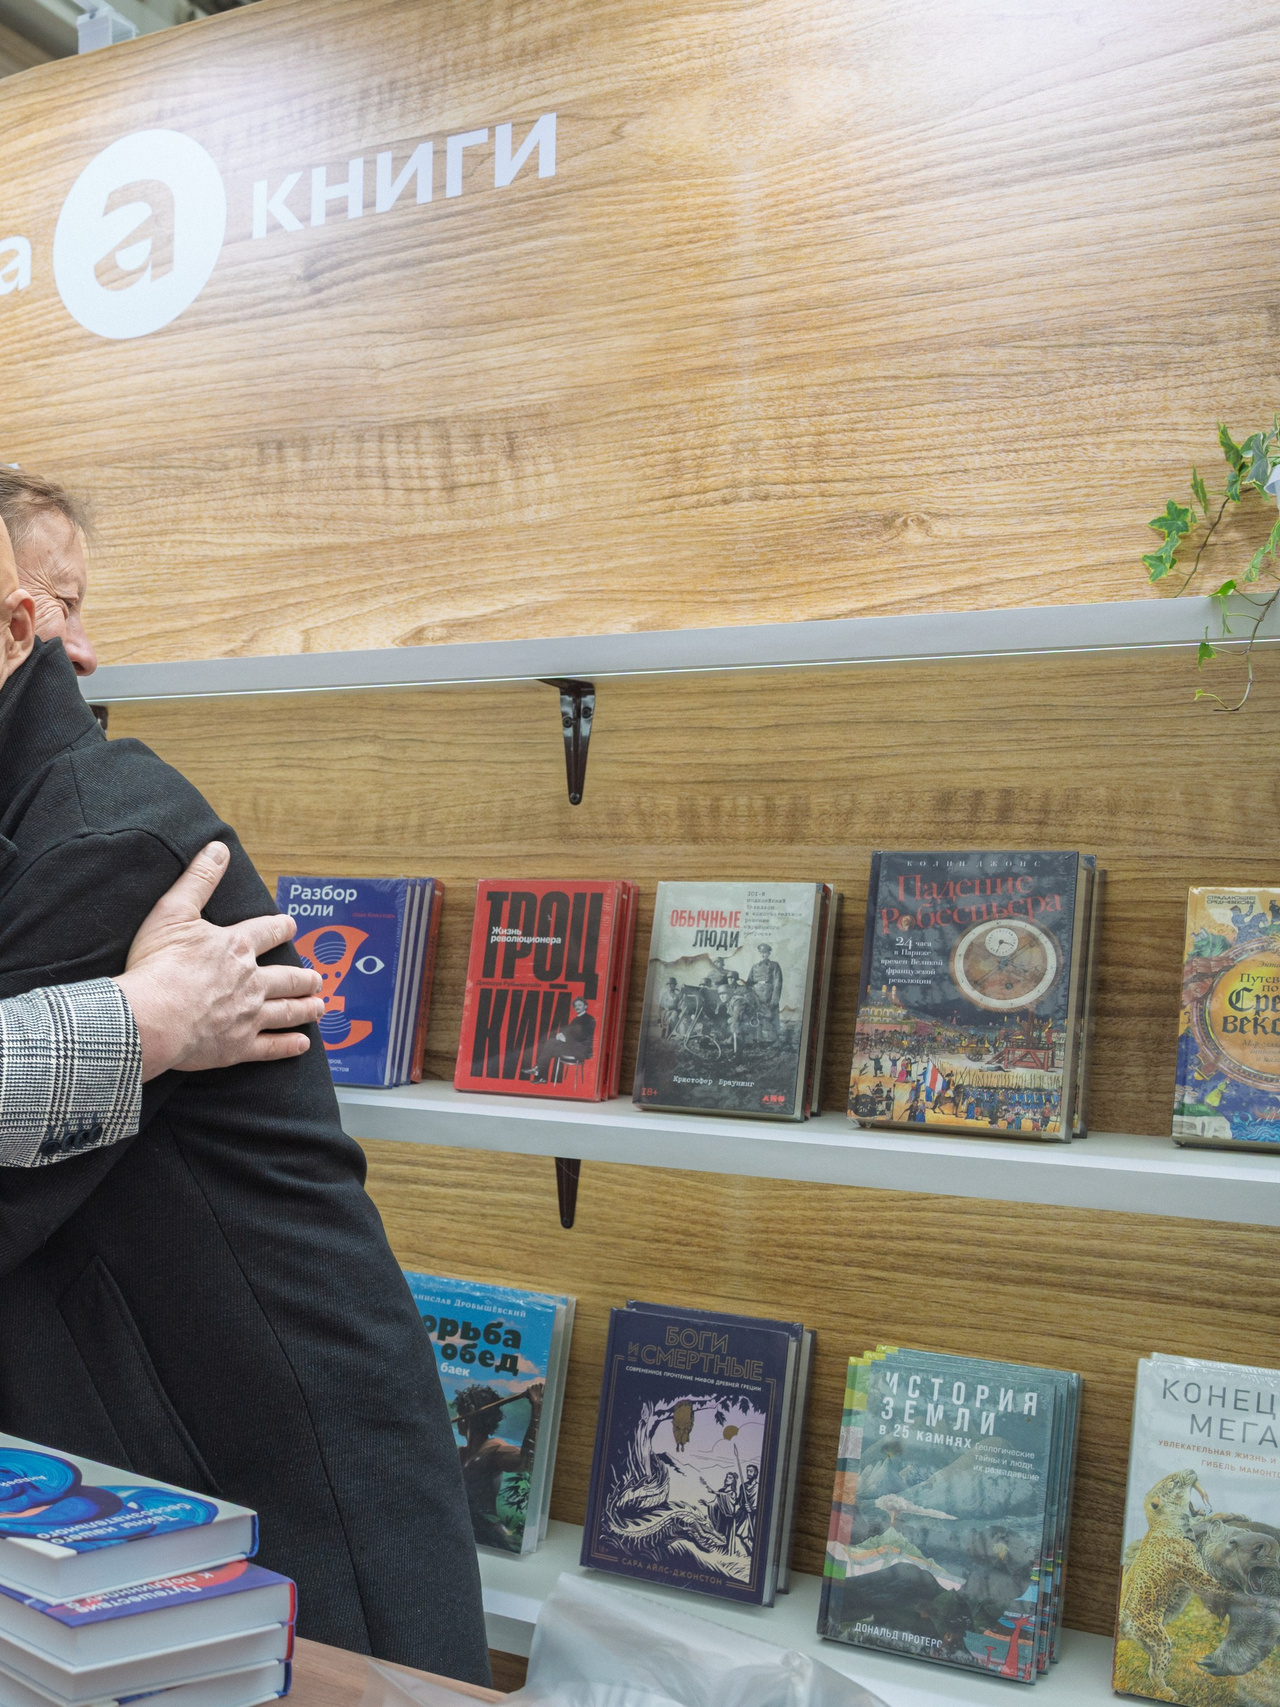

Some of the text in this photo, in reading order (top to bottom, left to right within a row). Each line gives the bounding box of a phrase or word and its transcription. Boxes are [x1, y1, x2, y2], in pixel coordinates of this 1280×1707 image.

[907, 860, 1041, 868] КОЛИН ДЖОНС
[290, 884, 358, 904] Разбор
[898, 873, 1033, 903] Падение
[287, 903, 334, 917] роли
[670, 909, 741, 929] ОБЫЧНЫЕ
[880, 893, 1063, 935] Робеспьера
[490, 935, 562, 945] революционера
[491, 926, 523, 935] Жизнь
[692, 929, 740, 951] ЛЮДИ
[482, 890, 604, 1000] ТРОЦ
[895, 936, 913, 950] 24
[901, 949, 932, 957] Париже
[886, 967, 936, 976] французской
[910, 958, 943, 966] Великой
[673, 1074, 755, 1088] Кристофер Браунинг
[413, 1293, 452, 1305] АНИСЛАВ
[422, 1314, 523, 1349] орьба
[665, 1325, 730, 1354] БОГИ
[440, 1362, 471, 1377] баек
[441, 1342, 519, 1376] обед
[641, 1344, 764, 1382] СМЕРТНЫЕ
[625, 1365, 762, 1391] СОВРЕМЕННОЕ ПРОЧТЕНИЕ МИФОВ ДРЕВНЕЙ ГРЕЦИИ
[885, 1371, 1038, 1416] ИСТОРИЯ
[1162, 1378, 1276, 1420] КОНЕЦ
[881, 1397, 995, 1436] ЗЕМЛИ
[893, 1424, 910, 1439] 25
[916, 1430, 972, 1449] камнях
[1190, 1413, 1278, 1449] МЕГА
[975, 1442, 1035, 1459] Геологические
[975, 1454, 1000, 1464] тайны
[1158, 1440, 1231, 1457] УВЛЕКАТЕЛЬНАЯ
[1234, 1451, 1267, 1463] ЖИЗНЬ
[984, 1466, 1040, 1481] разгадавшие
[1201, 1460, 1236, 1471] ГИБЕЛЬ
[36, 1502, 192, 1540] бессознательного
[51, 1514, 179, 1545] Тайны нашего
[621, 1557, 723, 1585] САРА АЙЛС-ДЖОНСТОН
[75, 1584, 202, 1614] Путешествие
[854, 1622, 898, 1640] ДОНАЛЬД
